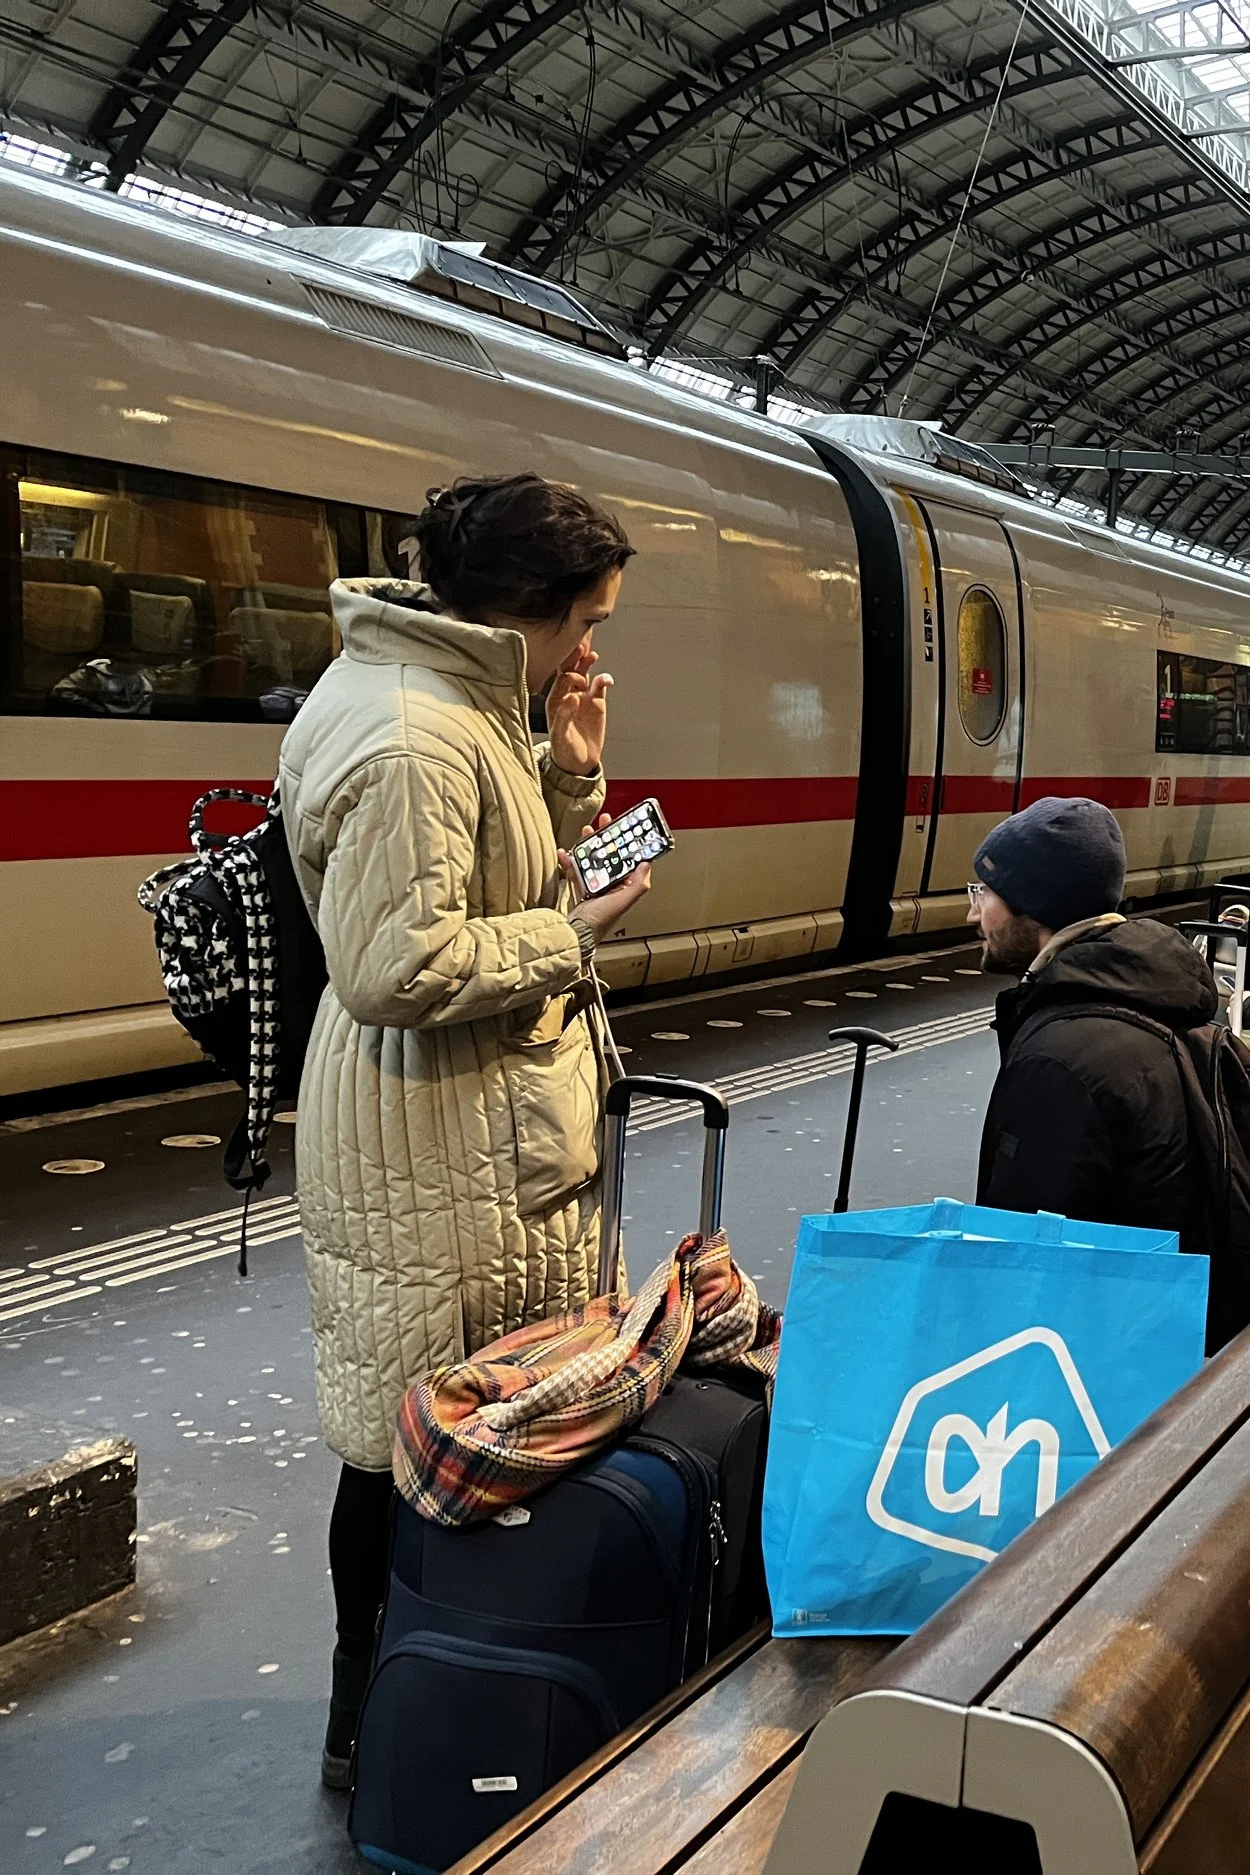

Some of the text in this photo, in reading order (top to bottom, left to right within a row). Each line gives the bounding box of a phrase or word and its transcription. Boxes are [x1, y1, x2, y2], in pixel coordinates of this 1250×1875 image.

[398, 536, 422, 583] 1
[923, 586, 931, 604] 1
[1164, 664, 1174, 699] 1
[1156, 781, 1169, 801] DB
